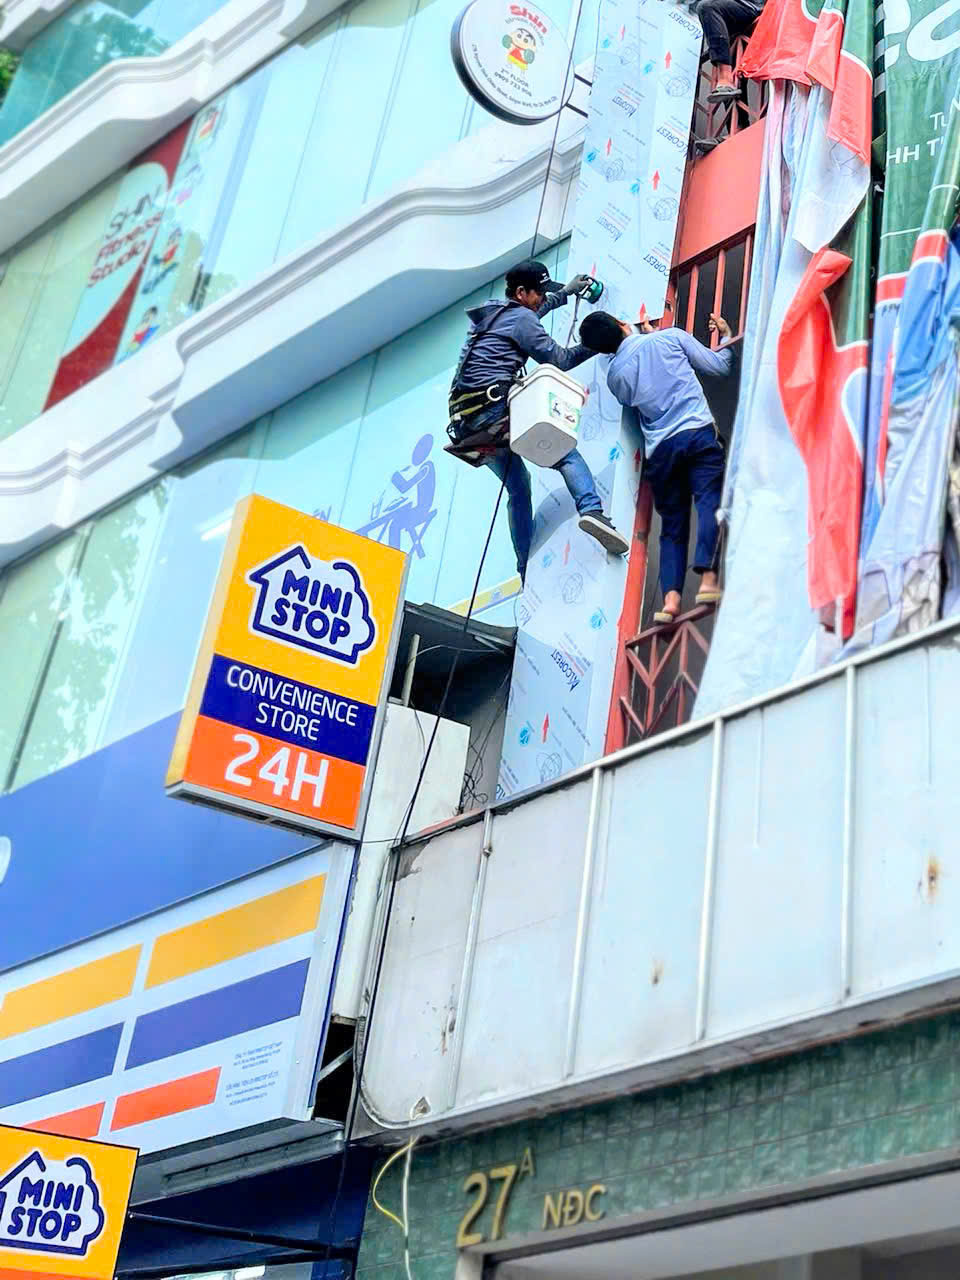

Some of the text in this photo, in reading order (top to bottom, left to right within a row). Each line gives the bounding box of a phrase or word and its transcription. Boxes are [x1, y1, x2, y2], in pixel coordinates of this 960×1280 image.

[282, 569, 353, 618] MINI
[271, 598, 350, 644] STOP
[226, 665, 359, 727] CONVENIENCE
[255, 702, 321, 741] STORE
[224, 733, 330, 808] 24H
[18, 1176, 84, 1212] MINI
[542, 1183, 607, 1230] NĐC
[7, 1206, 82, 1241] STOP
